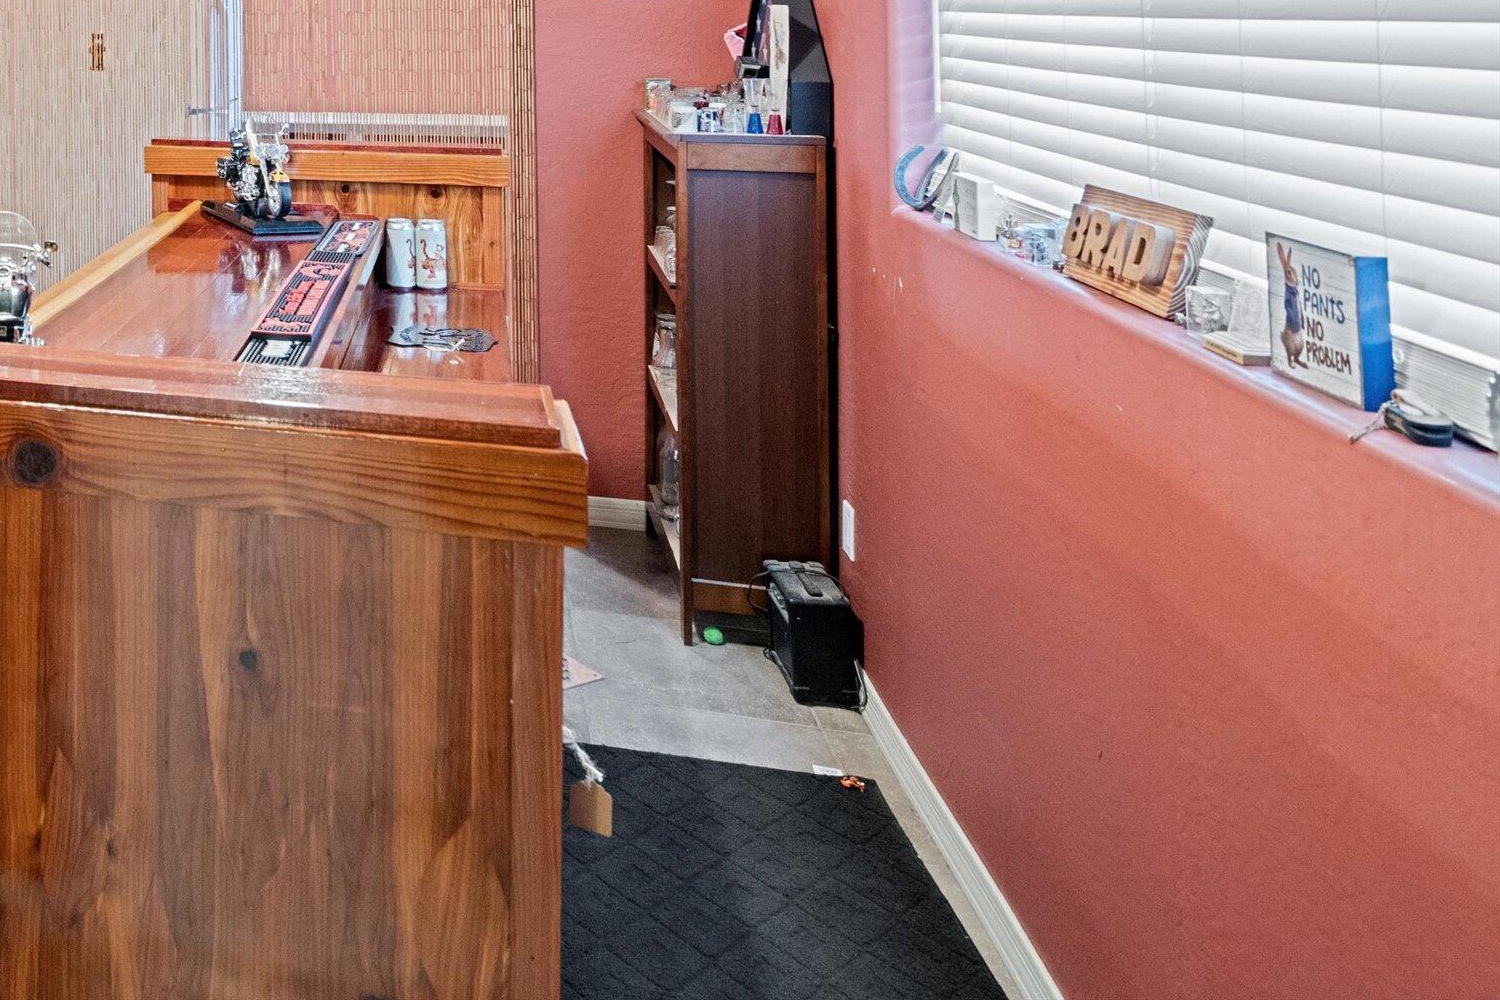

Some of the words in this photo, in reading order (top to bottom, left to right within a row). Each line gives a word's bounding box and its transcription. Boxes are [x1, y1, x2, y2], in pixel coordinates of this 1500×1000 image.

[1062, 203, 1156, 283] BRAD
[1302, 264, 1320, 290] NO
[1303, 290, 1346, 325] PANTS
[1306, 316, 1324, 342] NO
[1306, 341, 1352, 376] PROBLEM
